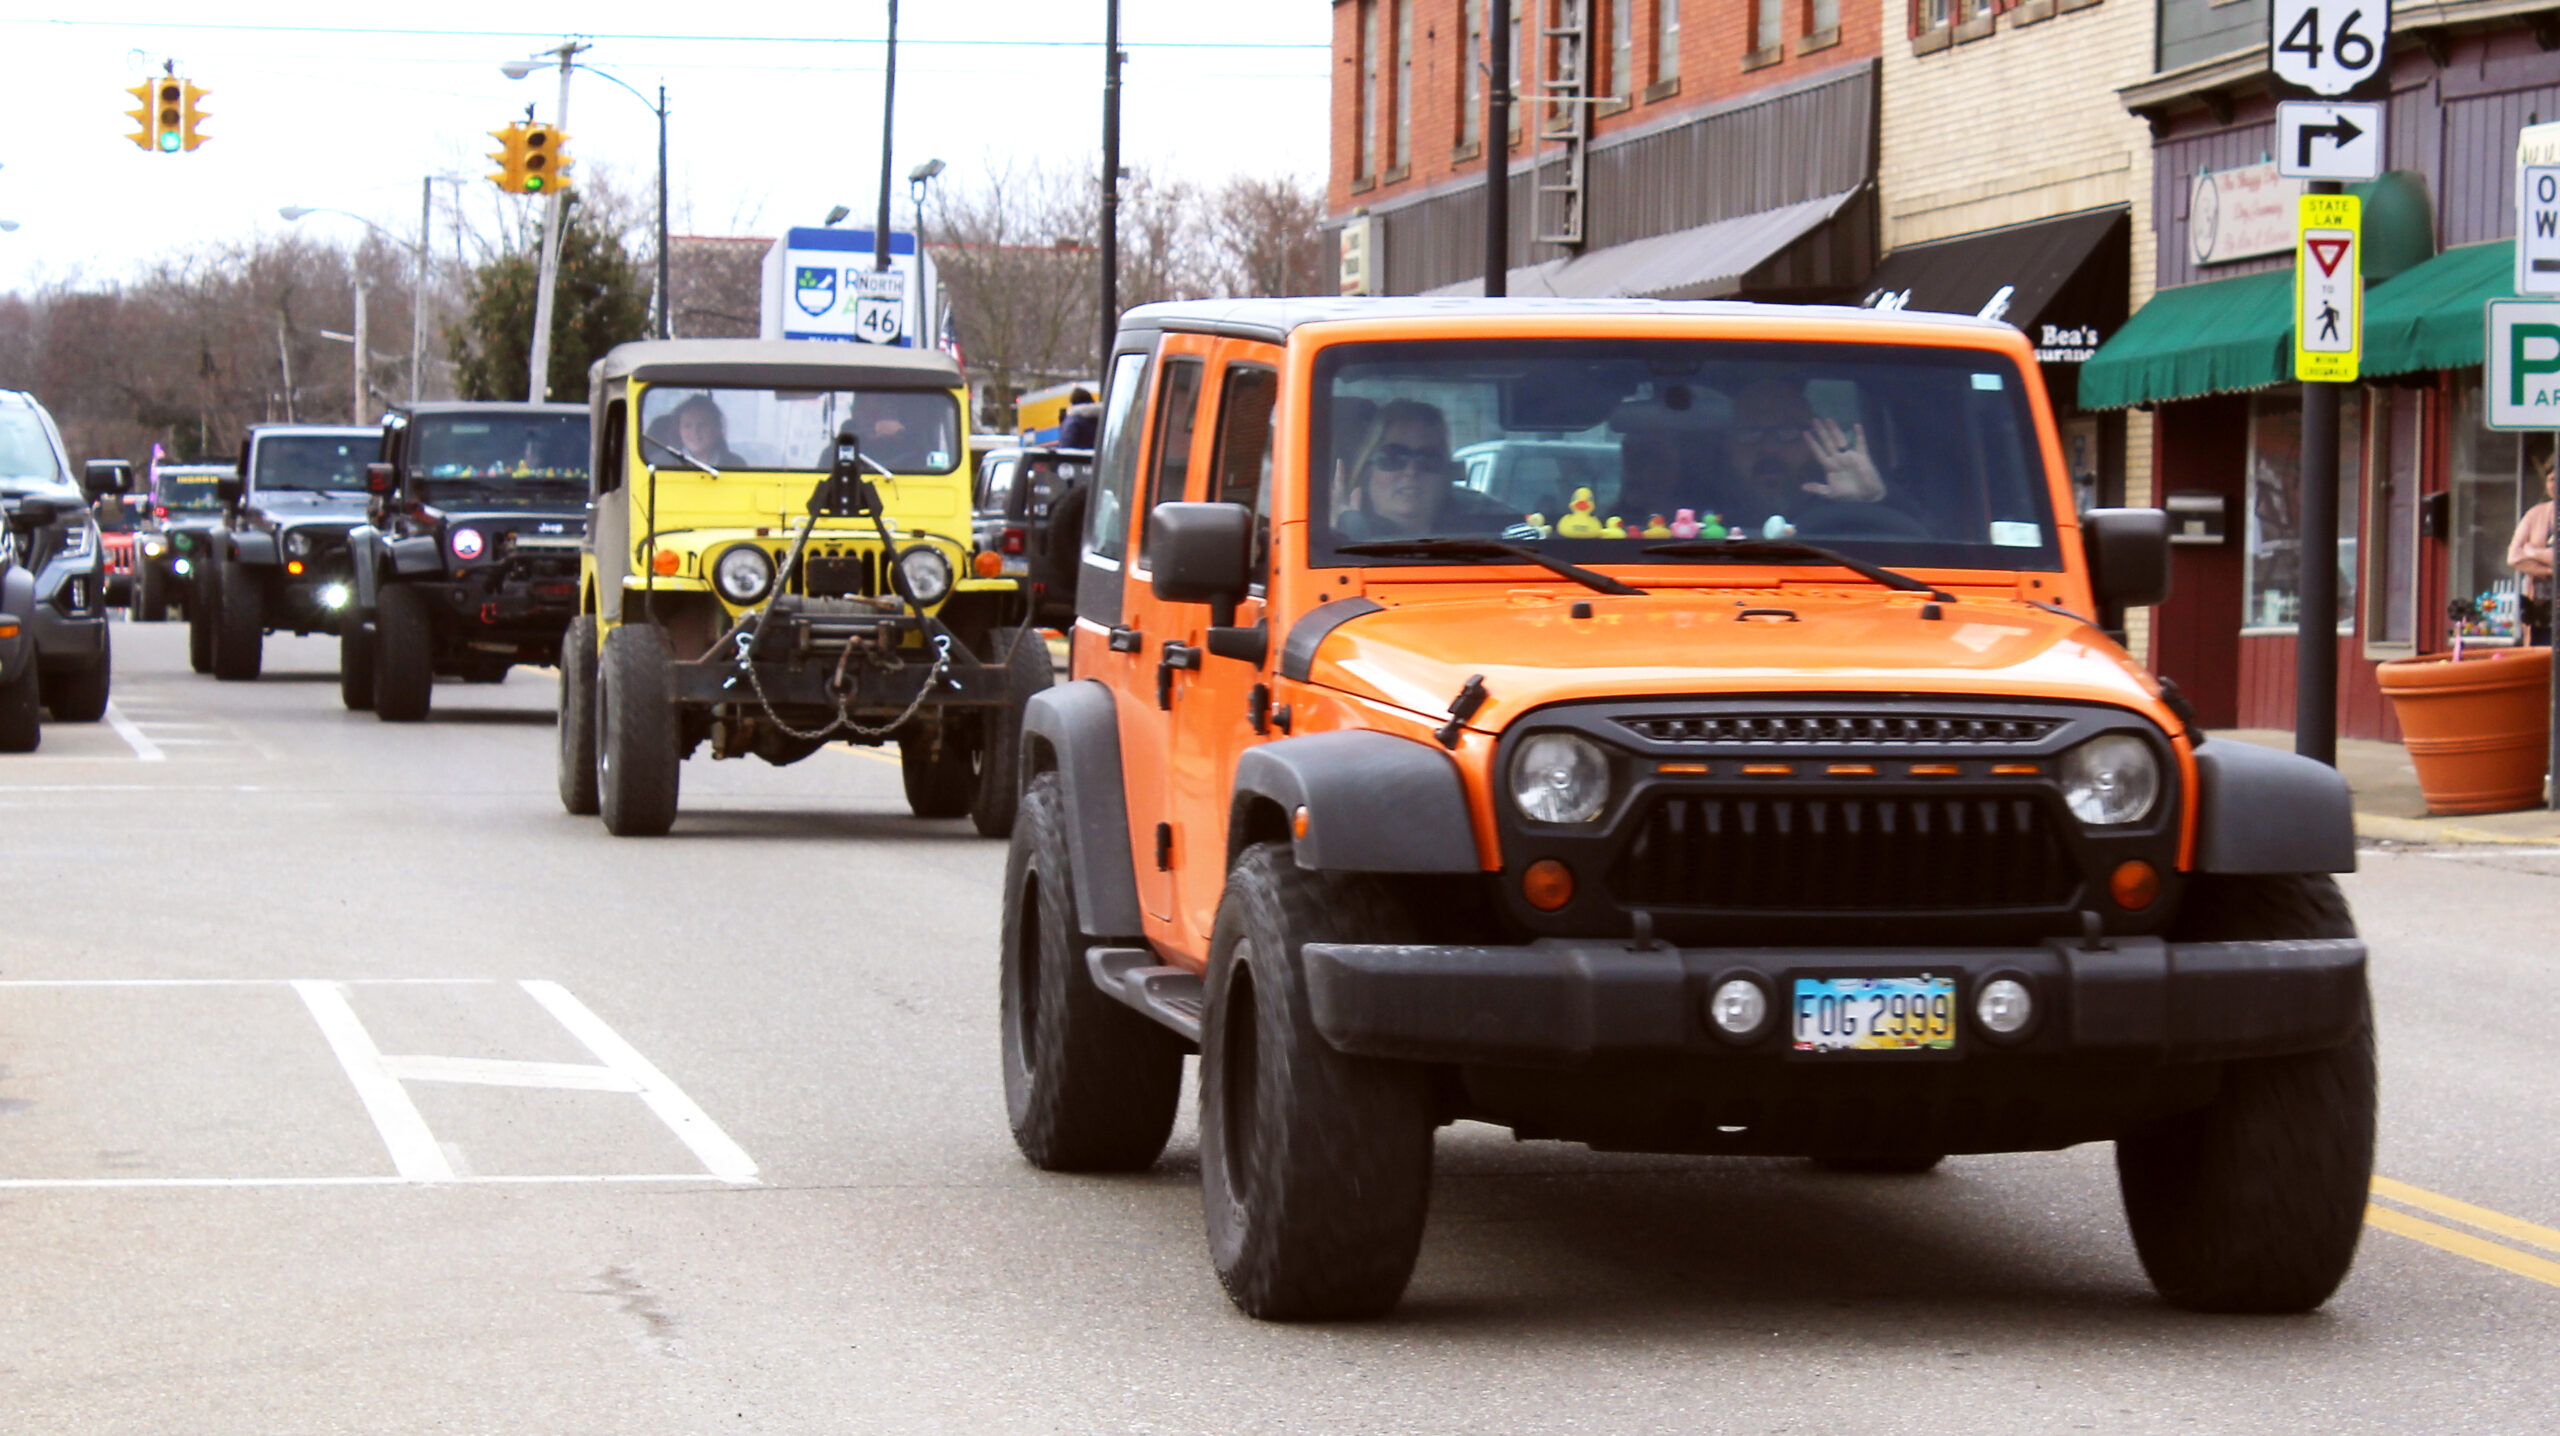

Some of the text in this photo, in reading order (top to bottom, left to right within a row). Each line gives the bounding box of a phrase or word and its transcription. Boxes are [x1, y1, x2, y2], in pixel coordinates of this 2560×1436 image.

[2279, 7, 2373, 70] 46
[2309, 201, 2349, 211] STATE
[2314, 215, 2343, 225] LAW
[859, 276, 902, 289] NORTH
[864, 308, 895, 333] 46
[2041, 325, 2098, 346] Bea's
[1798, 994, 1948, 1037] FOG 2999
